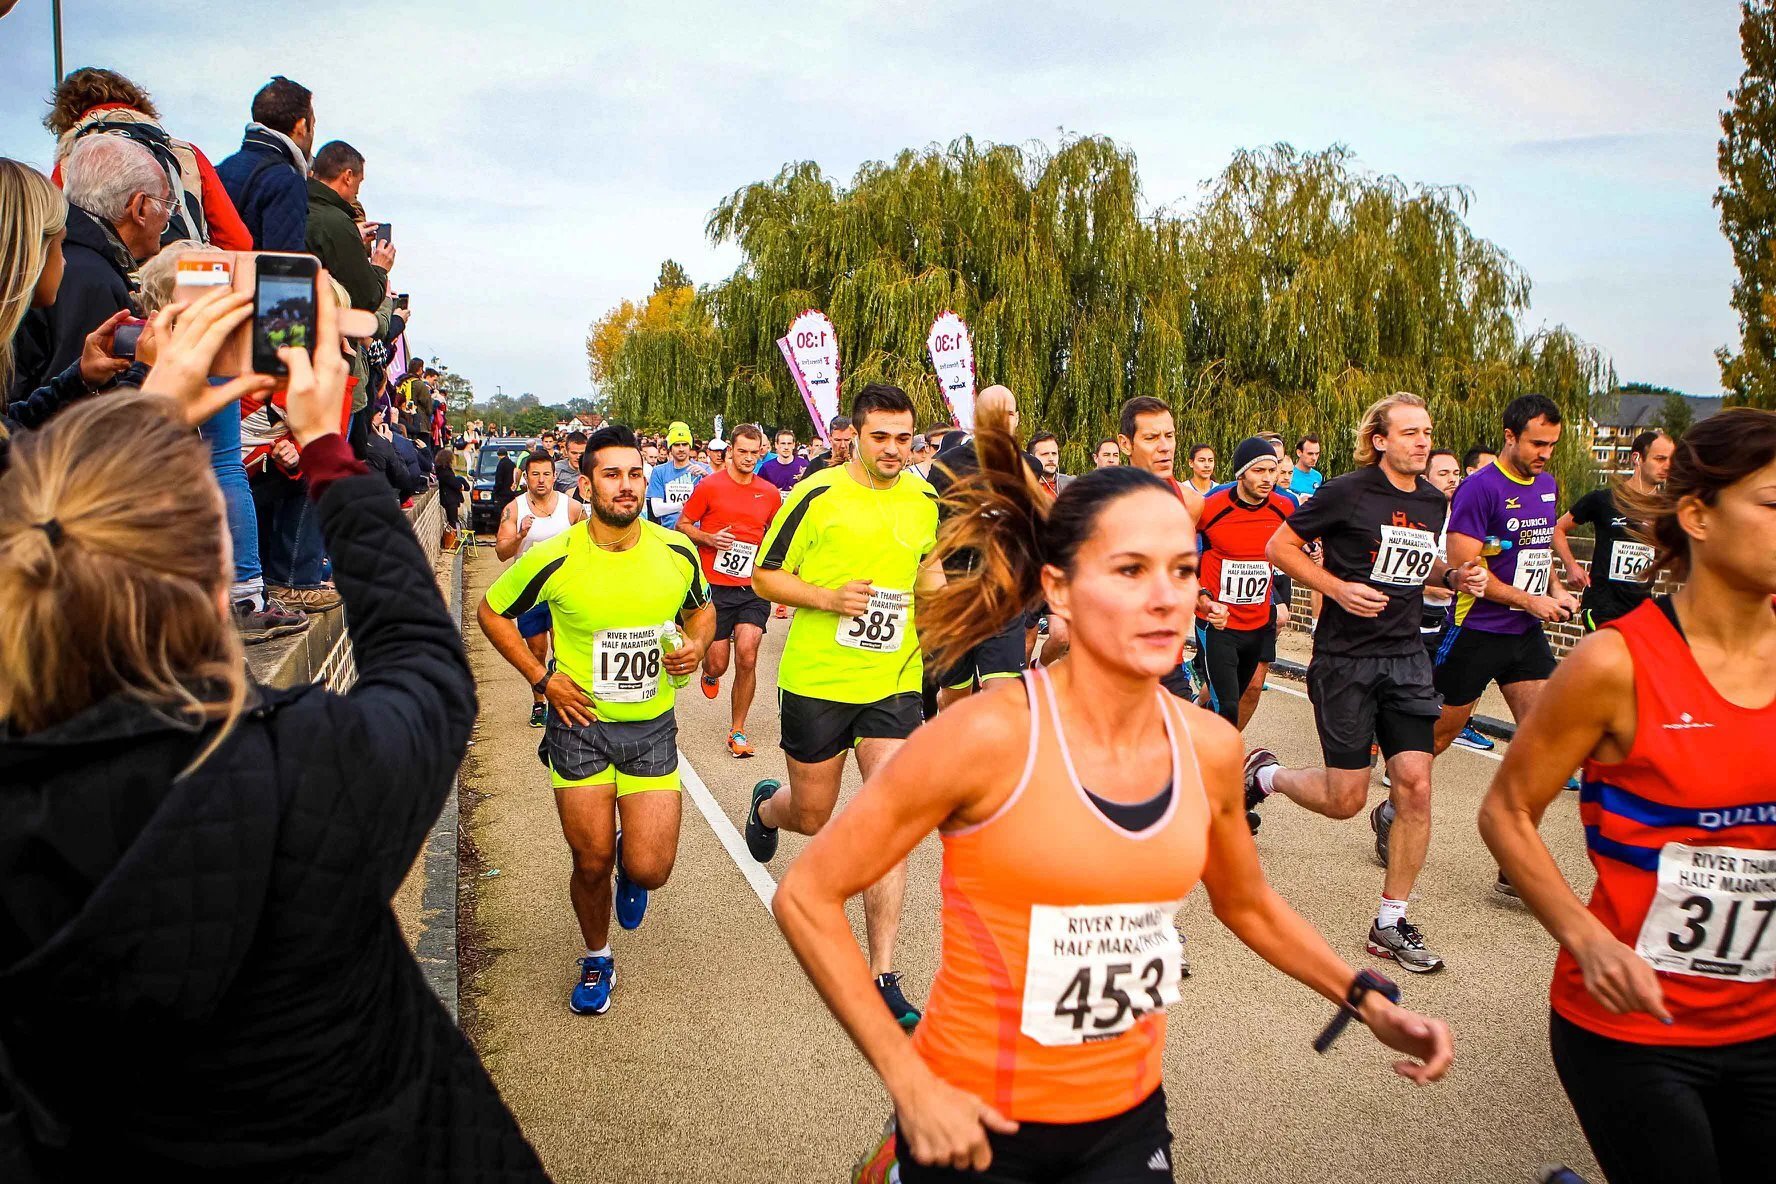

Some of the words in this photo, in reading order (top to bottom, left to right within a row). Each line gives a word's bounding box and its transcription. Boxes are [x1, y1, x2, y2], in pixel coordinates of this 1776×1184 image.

[1520, 518, 1548, 528] ZURICH
[720, 552, 750, 572] 587
[1381, 546, 1434, 578] 1798
[880, 592, 902, 602] THAMES
[1226, 576, 1268, 598] 1102
[870, 600, 903, 611] MARATHON
[607, 631, 628, 640] RIVER
[630, 630, 654, 639] THAMES
[848, 610, 898, 642] 585
[602, 640, 619, 648] HALF
[620, 638, 658, 649] MARATHON
[602, 648, 660, 682] 1208
[1692, 852, 1736, 872] RIVER
[1679, 870, 1717, 890] HALF
[1068, 916, 1113, 934] RIVER
[1668, 895, 1776, 961] 317
[1054, 938, 1092, 956] HALF
[1054, 958, 1164, 1030] 453
